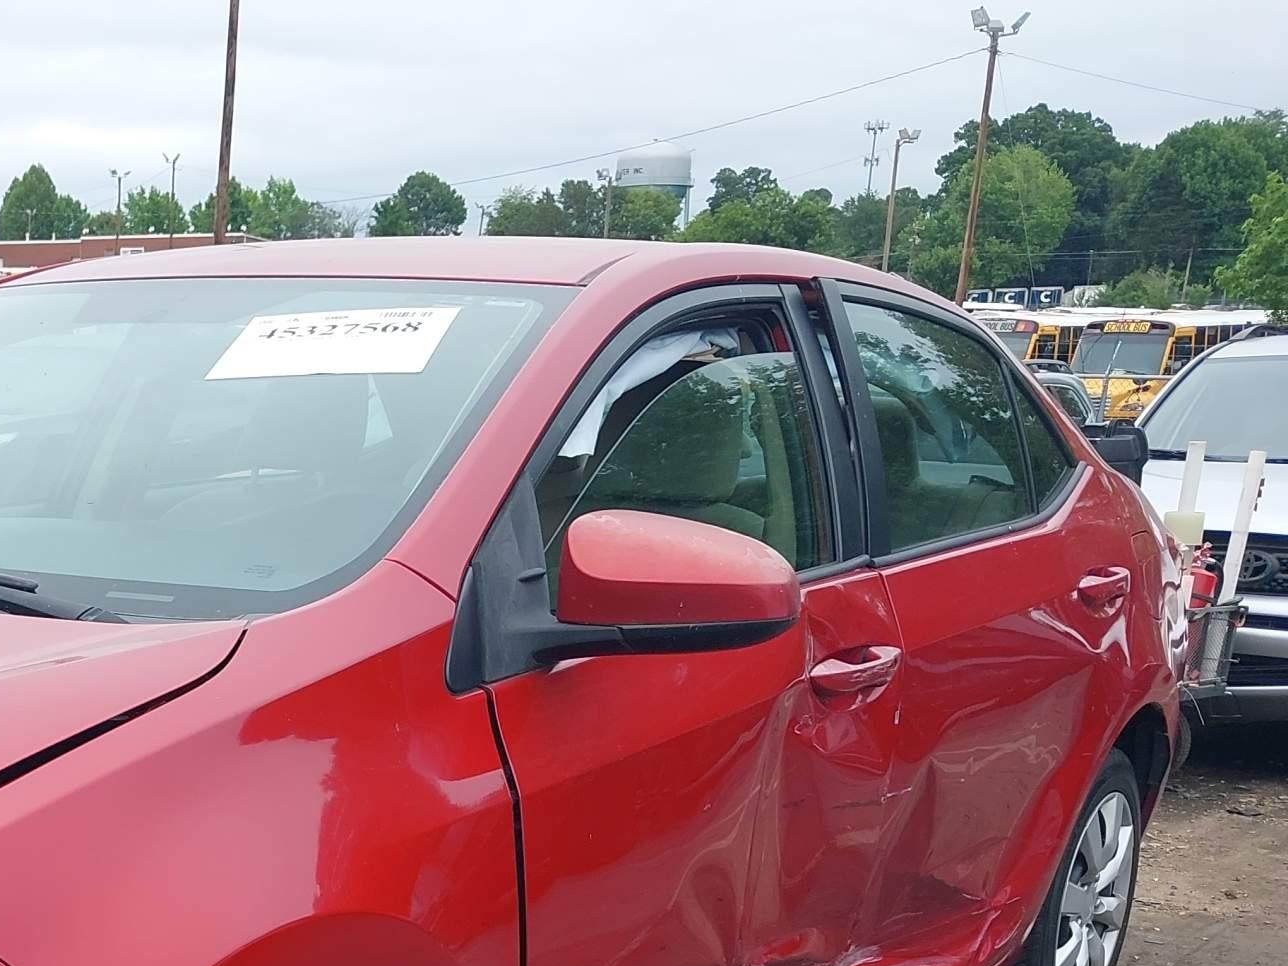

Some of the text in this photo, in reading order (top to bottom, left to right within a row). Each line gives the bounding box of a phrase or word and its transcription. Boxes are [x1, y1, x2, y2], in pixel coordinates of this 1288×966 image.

[1004, 292, 1016, 303] C
[1040, 291, 1052, 302] C
[258, 321, 423, 339] 45327568
[1133, 323, 1149, 332] BUS
